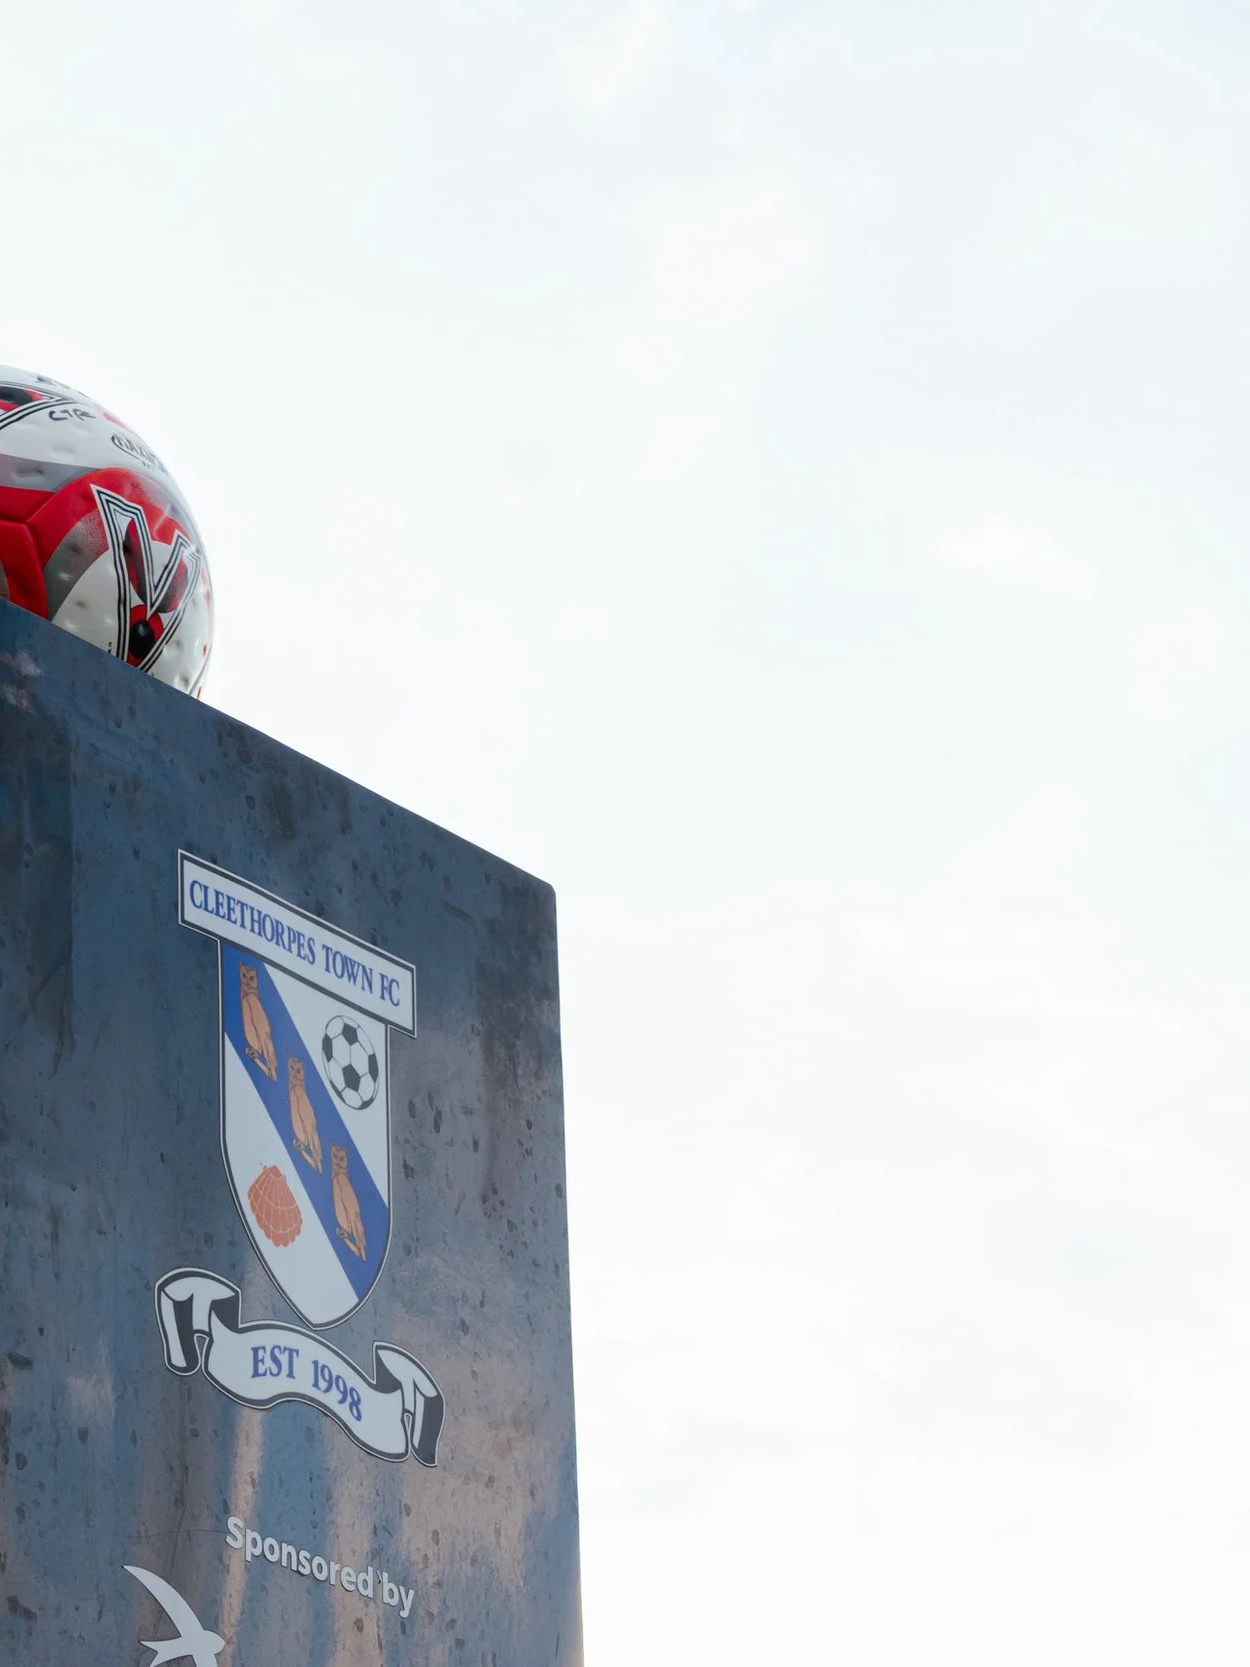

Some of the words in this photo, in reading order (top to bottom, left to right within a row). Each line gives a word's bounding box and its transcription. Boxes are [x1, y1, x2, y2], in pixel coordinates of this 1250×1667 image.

[189, 879, 316, 966] CLEETHORPES
[321, 943, 374, 995] TOWN
[379, 973, 400, 1007] FC
[251, 1344, 299, 1380] EST
[311, 1359, 363, 1423] 1998
[225, 1516, 375, 1599] Sponsored
[381, 1571, 415, 1619] by
